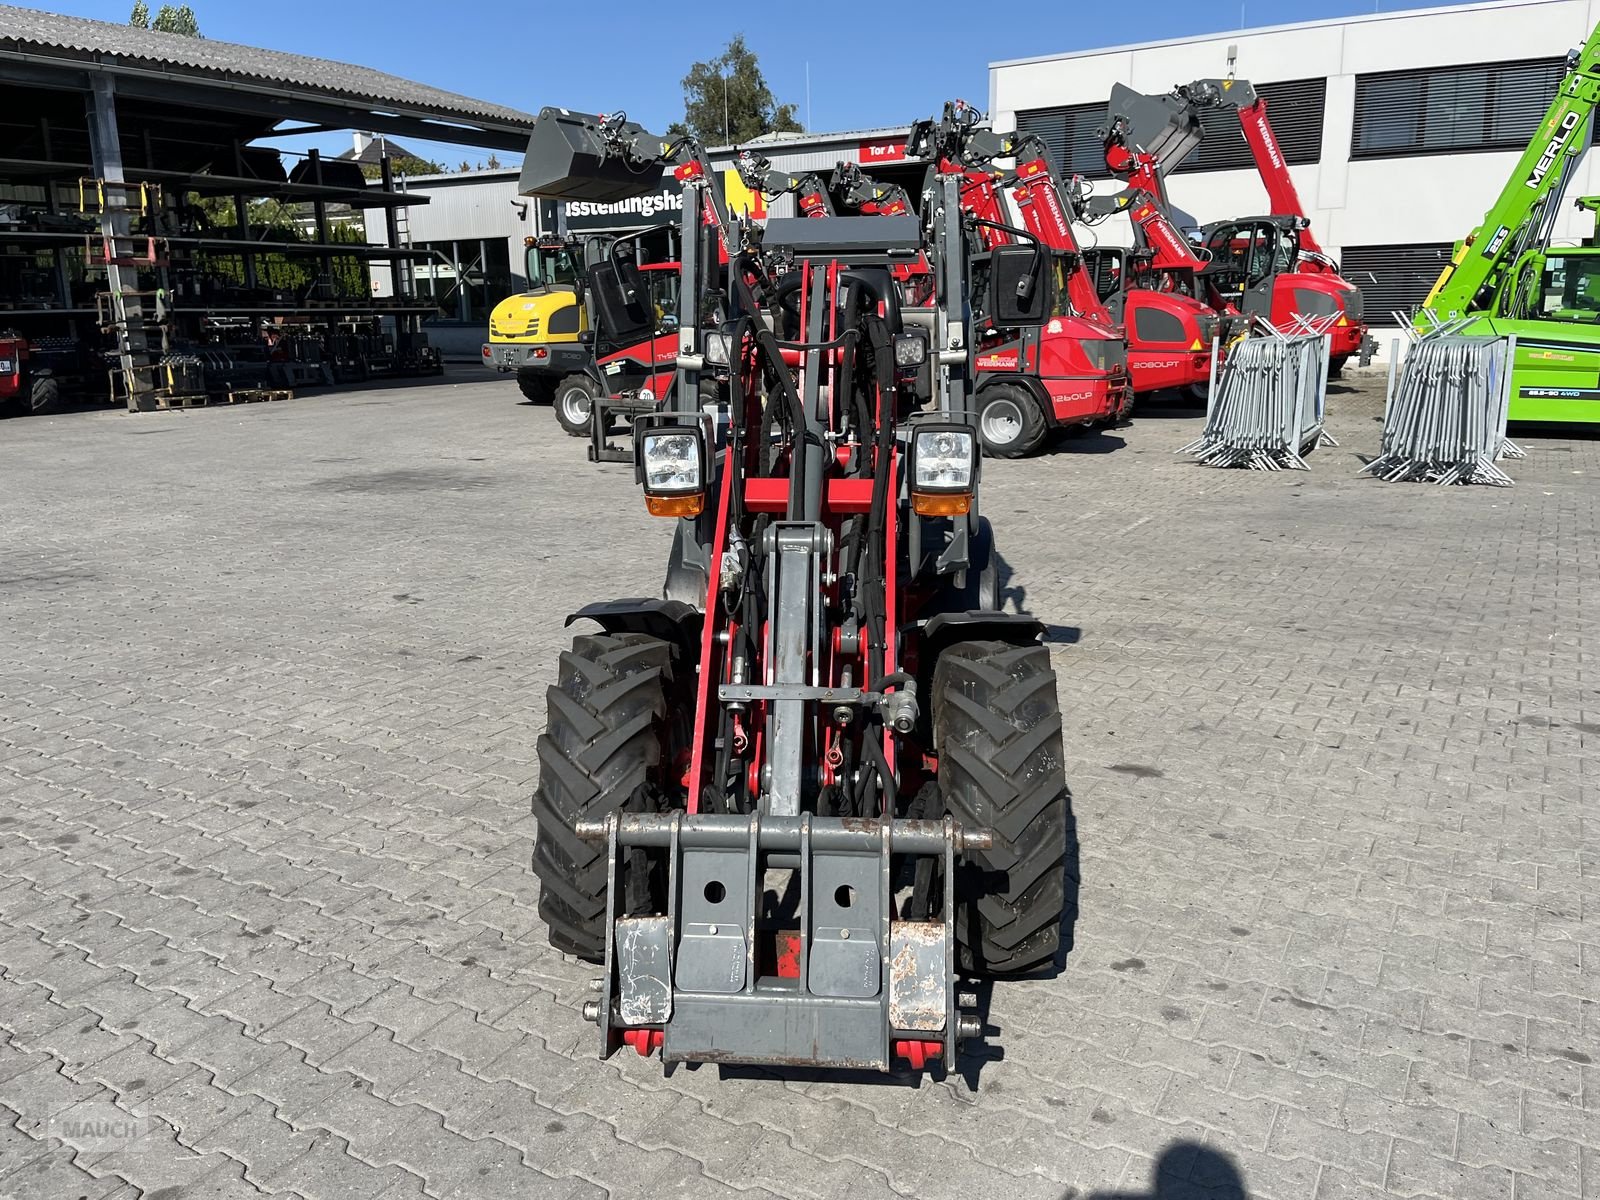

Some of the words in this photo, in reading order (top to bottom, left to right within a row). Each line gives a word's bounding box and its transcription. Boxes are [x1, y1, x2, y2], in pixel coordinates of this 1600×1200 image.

[869, 146, 886, 156] Tor
[887, 145, 895, 154] A
[1257, 117, 1281, 169] WEIDEMANN
[1526, 112, 1580, 189] MERLO
[1044, 185, 1067, 236] WEIDEMANN
[1157, 221, 1186, 257] WEIDEMANN
[1490, 229, 1508, 254] 25.5
[1133, 361, 1179, 369] 2080LPT
[1053, 391, 1093, 403] 1260LP
